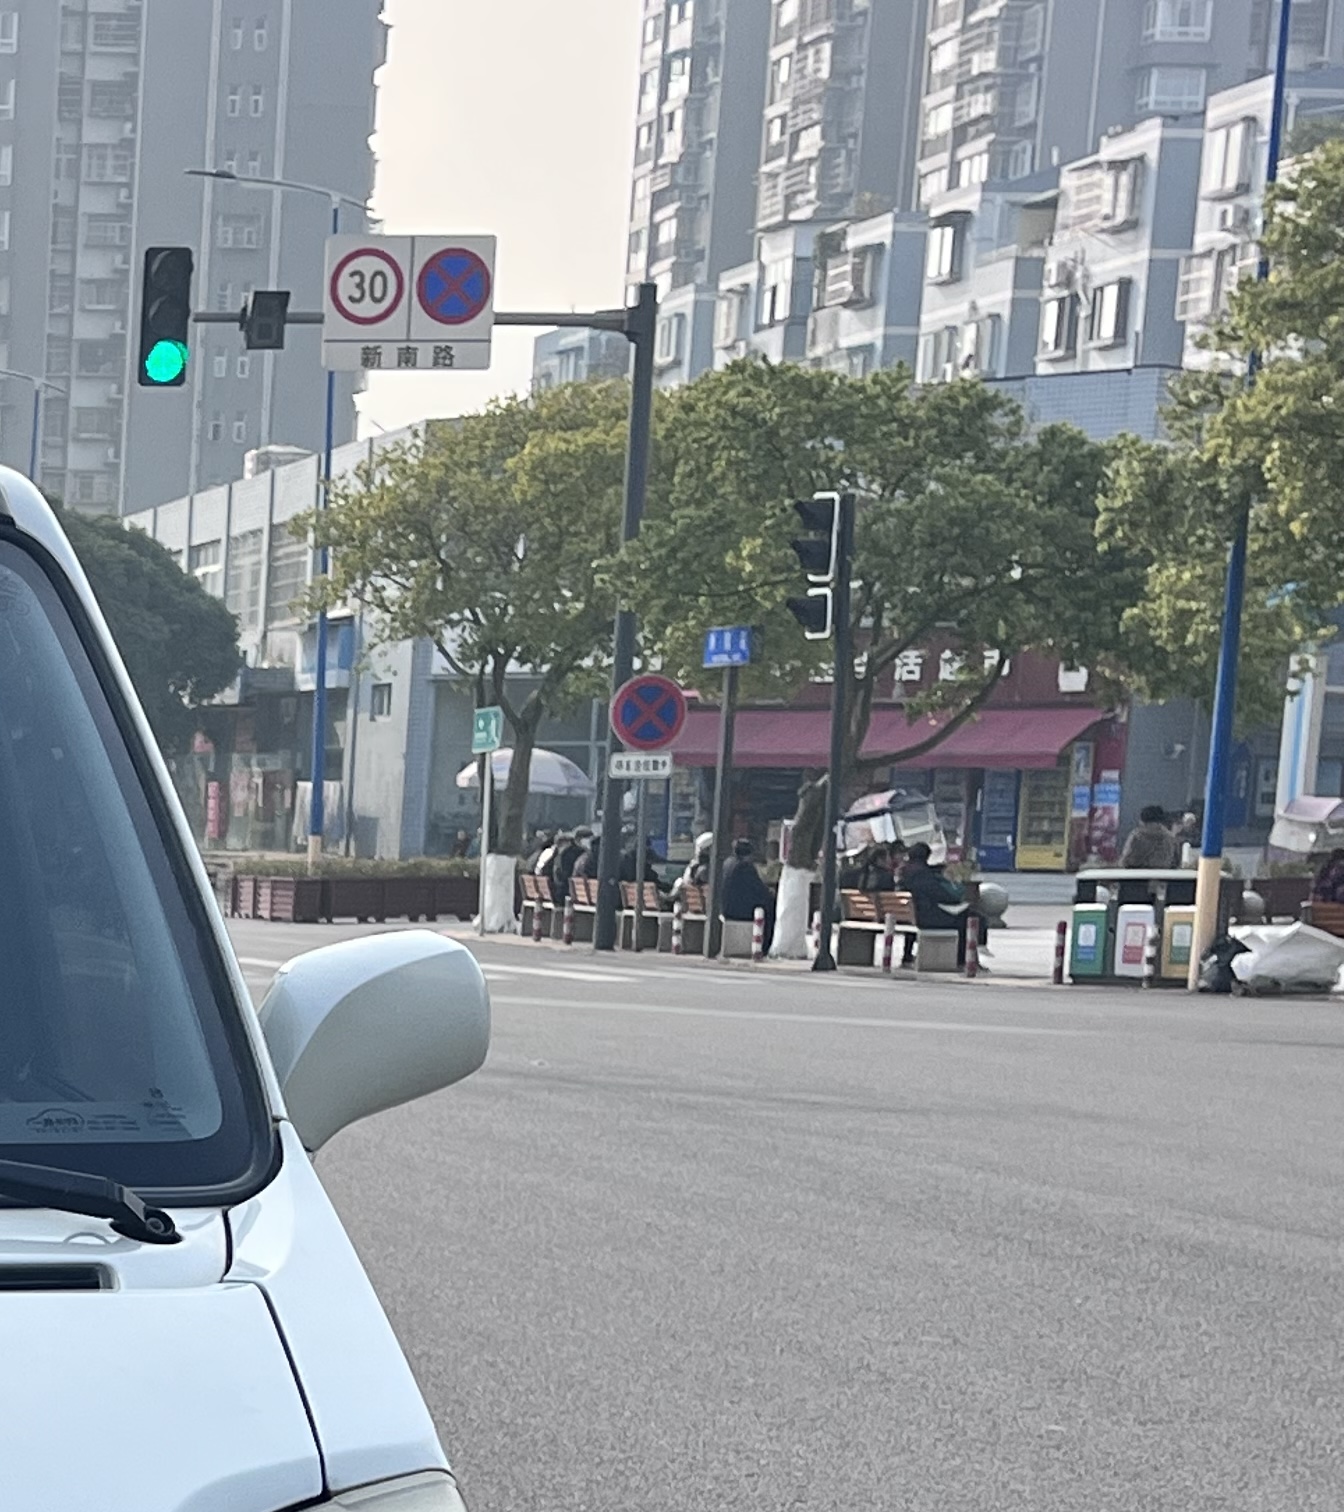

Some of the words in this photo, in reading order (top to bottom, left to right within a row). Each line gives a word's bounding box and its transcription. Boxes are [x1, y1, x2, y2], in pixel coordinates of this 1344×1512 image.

[348, 270, 387, 304] 30
[361, 345, 454, 368] 新南路
[808, 647, 1011, 683] 活超市
